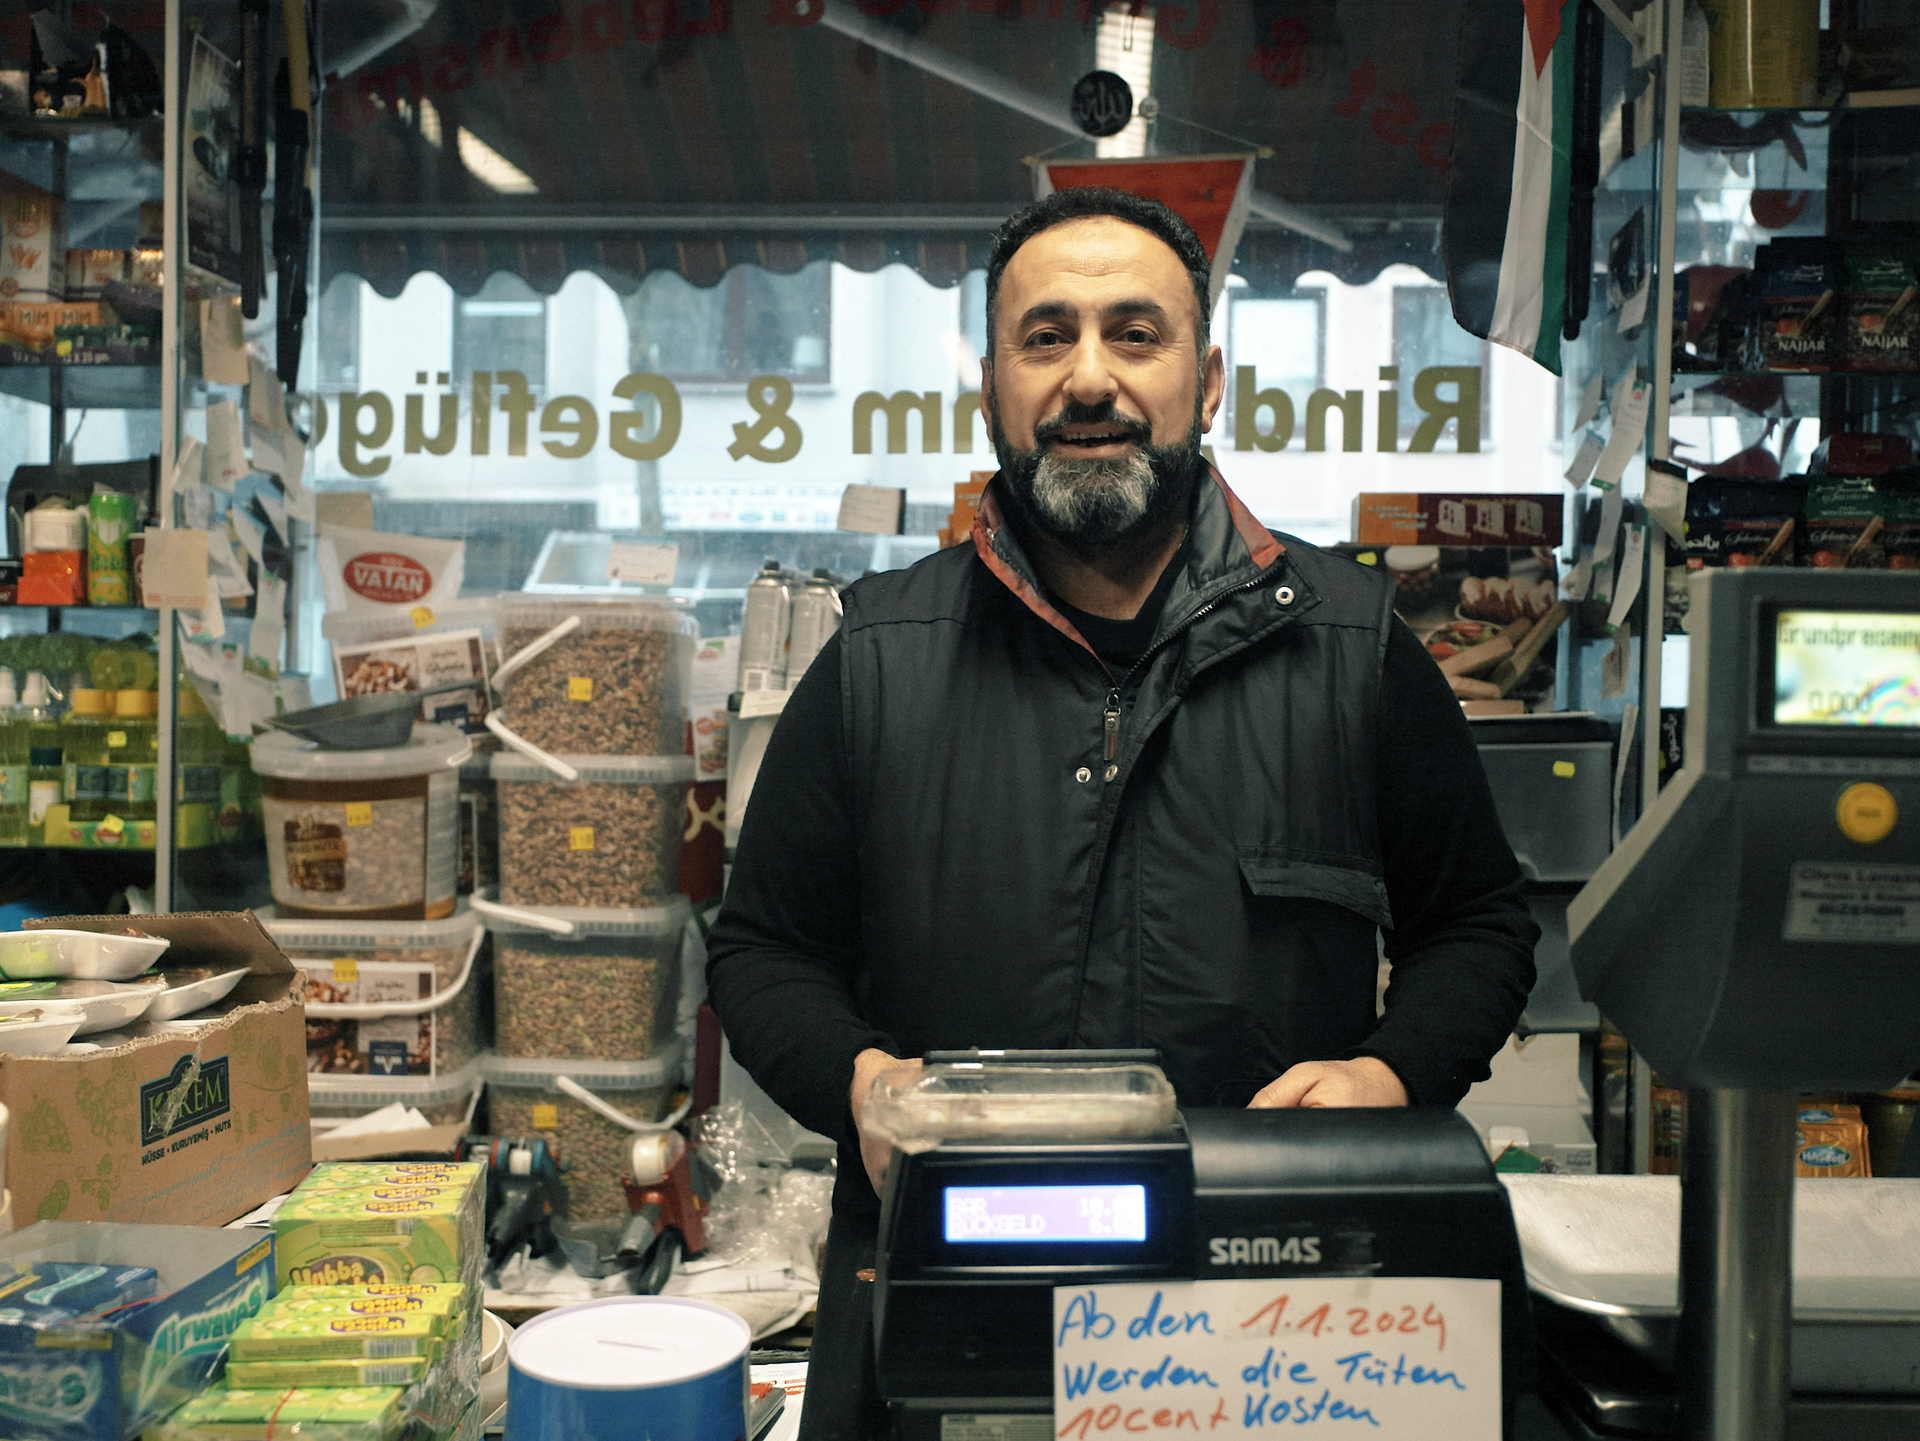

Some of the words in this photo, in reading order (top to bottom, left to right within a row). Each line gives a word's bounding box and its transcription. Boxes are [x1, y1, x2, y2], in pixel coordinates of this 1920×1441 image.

[1778, 339, 1826, 353] NAJJAR
[1861, 335, 1910, 349] NAJJAR
[354, 562, 424, 594] VATAN
[141, 1147, 165, 1166] NÜSSE
[214, 1119, 232, 1135] NUTS
[1209, 1236, 1322, 1265] SAM4S
[291, 1260, 364, 1285] Hubba
[151, 1282, 262, 1373] Airwaves
[1058, 1290, 1116, 1347] Ab
[1127, 1291, 1216, 1340] den
[1240, 1294, 1447, 1352] 1.1.2024
[1063, 1355, 1219, 1400] Werden
[1241, 1346, 1317, 1388] die
[1336, 1351, 1467, 1391] Tüten
